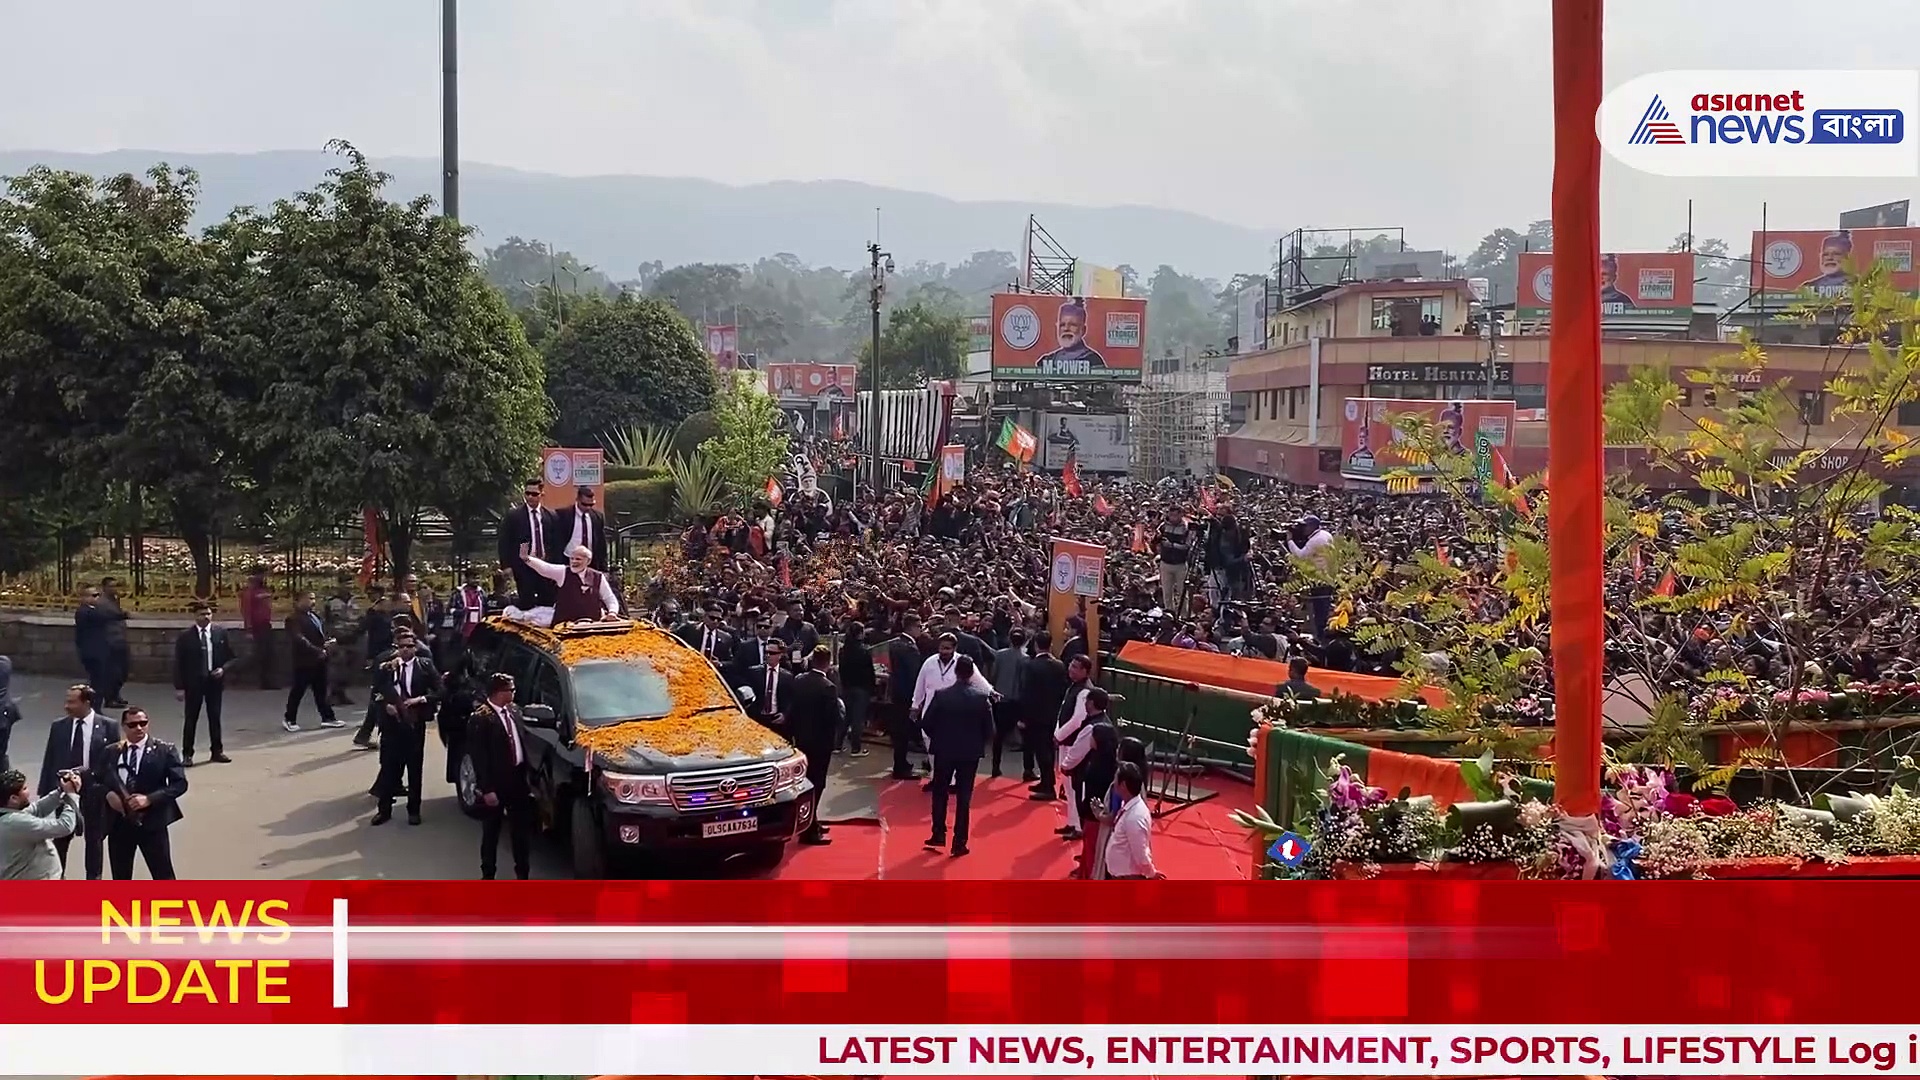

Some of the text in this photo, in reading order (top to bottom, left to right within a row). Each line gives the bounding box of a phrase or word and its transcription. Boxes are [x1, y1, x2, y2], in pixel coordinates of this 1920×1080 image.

[1042, 360, 1091, 375] M-POWER
[1369, 366, 1509, 381] HOTEL HERITAE
[1821, 456, 1849, 470] SHOP
